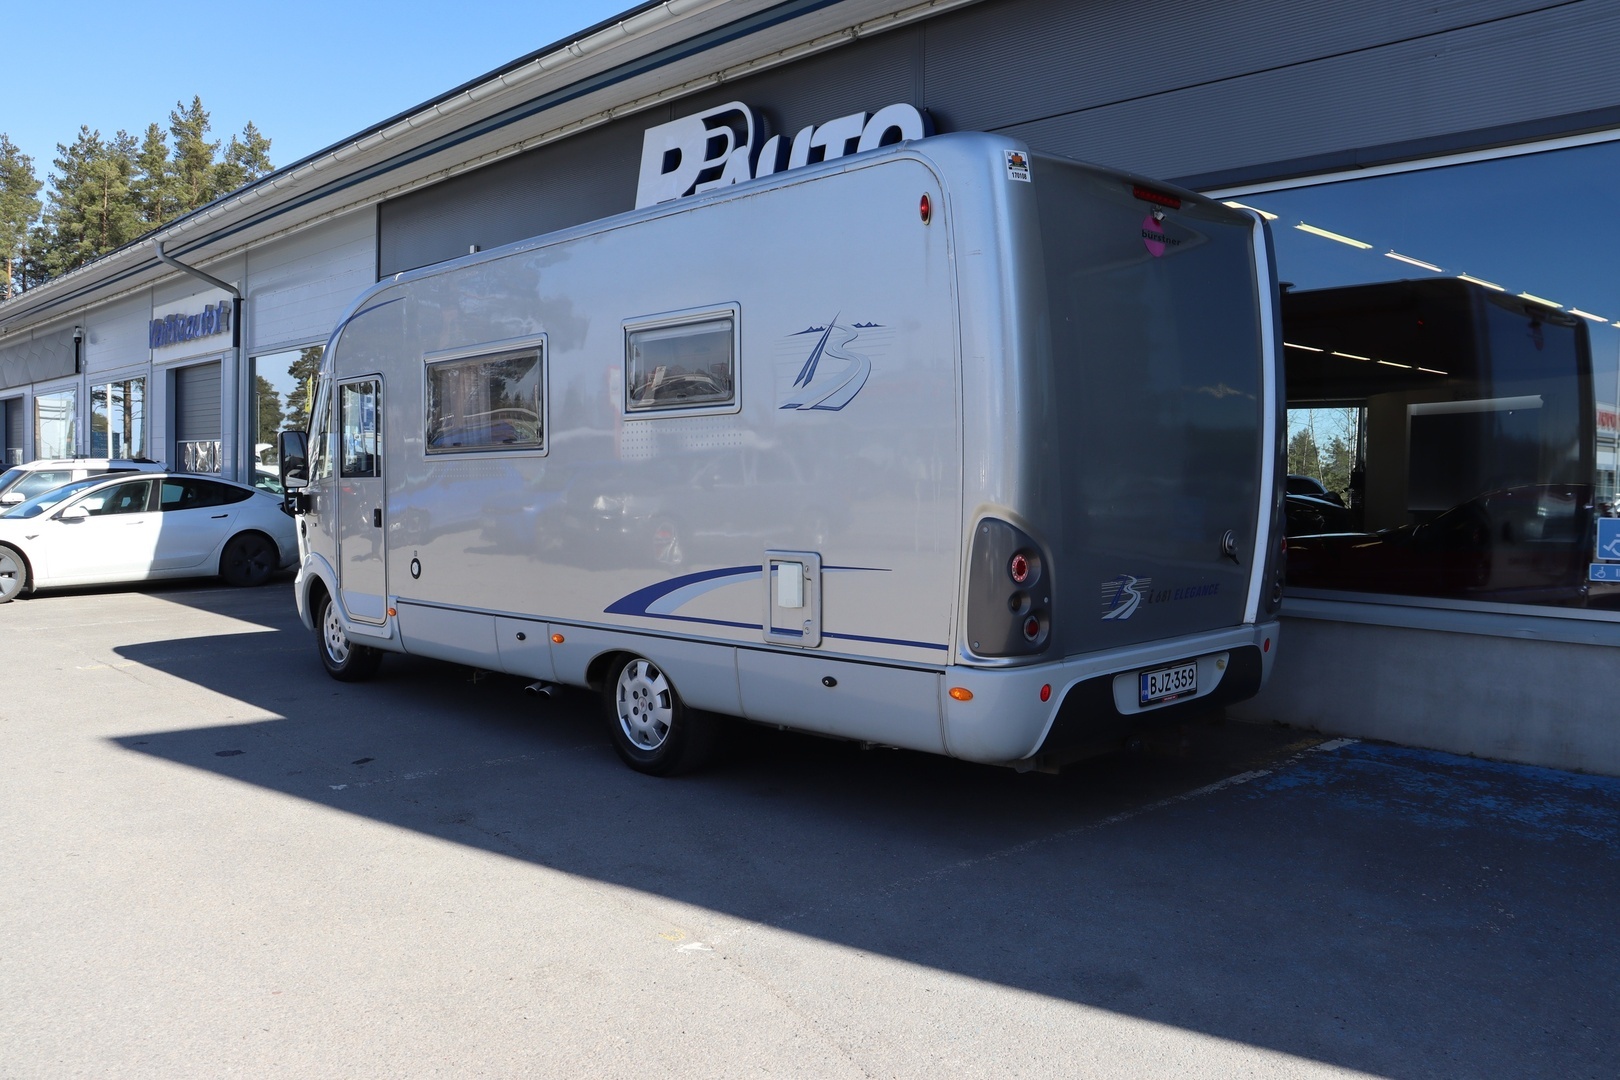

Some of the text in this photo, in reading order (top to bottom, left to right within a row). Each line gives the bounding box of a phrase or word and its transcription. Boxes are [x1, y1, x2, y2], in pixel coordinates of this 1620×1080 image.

[1141, 229, 1181, 246] bürstner
[1174, 583, 1220, 600] ELEGANCE
[1150, 668, 1195, 695] BJZ-359
